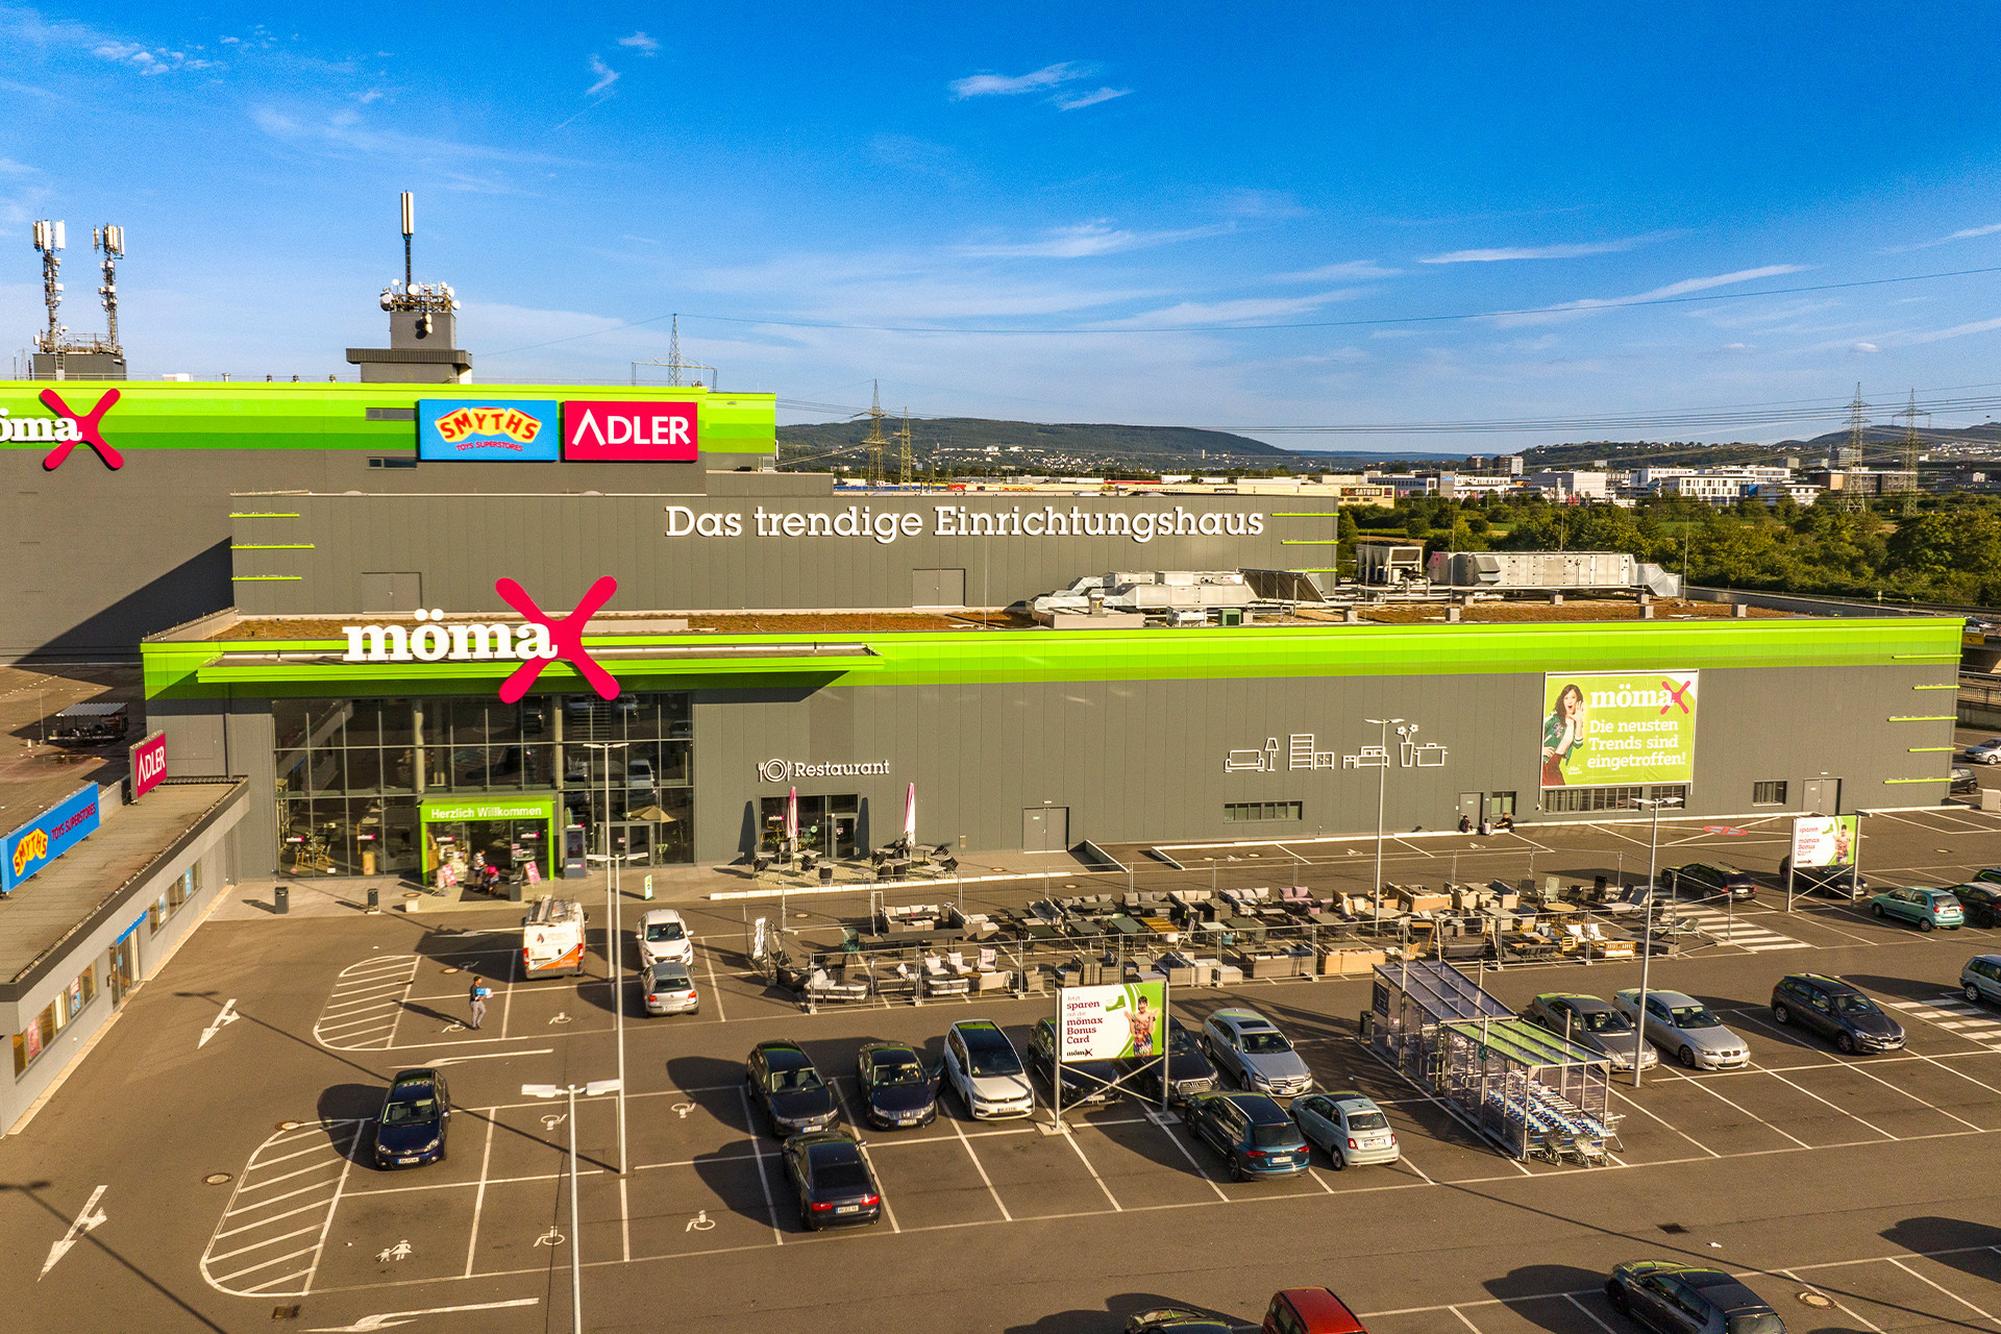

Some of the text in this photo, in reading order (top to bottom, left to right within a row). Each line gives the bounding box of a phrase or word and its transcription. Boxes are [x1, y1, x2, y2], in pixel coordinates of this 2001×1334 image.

[439, 412, 538, 440] SMYTHS
[572, 408, 691, 446] ADLER
[456, 442, 474, 451] TOYS
[665, 505, 1264, 544] Das trendige Einrichtungshaus
[342, 575, 621, 705] mömax
[1590, 680, 1691, 715] mömax
[1589, 719, 1679, 733] Die neusten
[1588, 734, 1680, 751] Trends sind
[138, 746, 165, 786] ADLER
[795, 760, 890, 777] Restaurant
[1586, 751, 1687, 771] eingetroffen!
[431, 806, 542, 819] Herzlich Willkommen
[14, 833, 47, 874] SMYTHS
[1067, 1001, 1100, 1011] sparen
[1067, 1017, 1103, 1026] mömax
[1067, 1027, 1097, 1035] Bonus
[1067, 1035, 1090, 1044] Card
